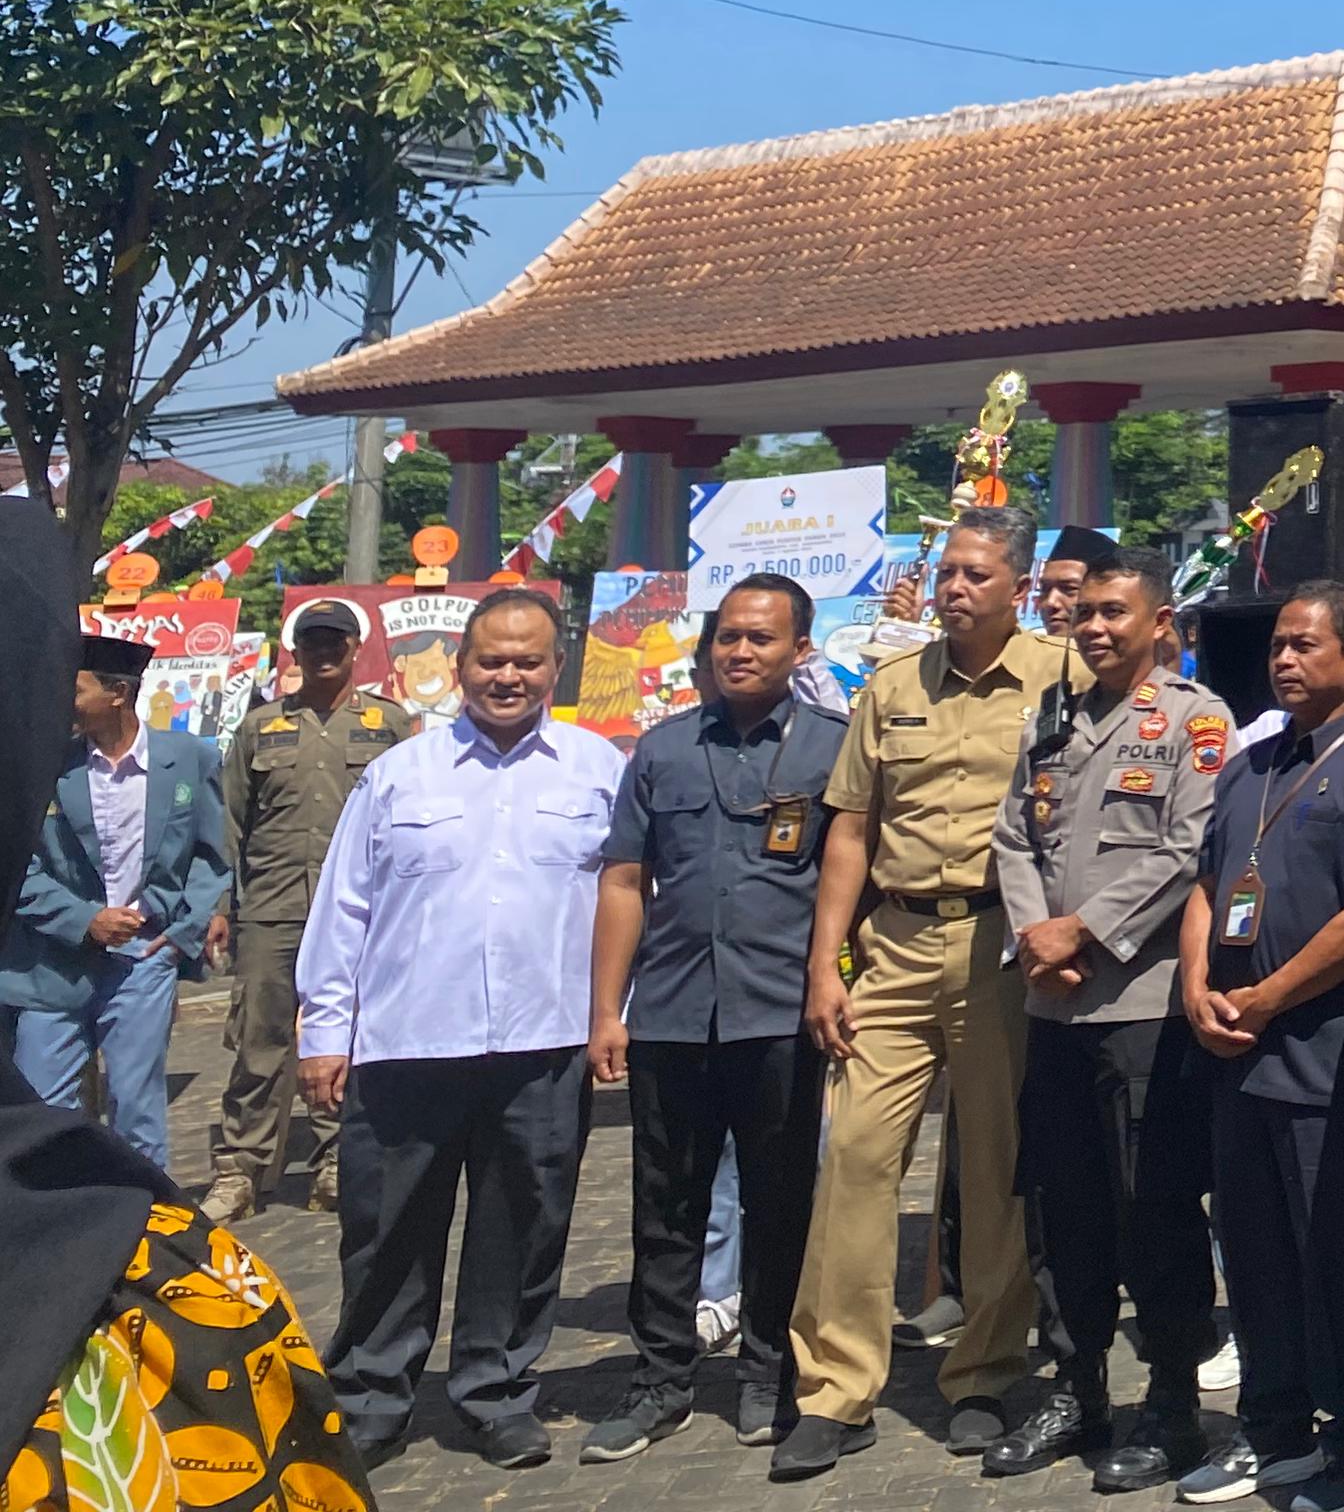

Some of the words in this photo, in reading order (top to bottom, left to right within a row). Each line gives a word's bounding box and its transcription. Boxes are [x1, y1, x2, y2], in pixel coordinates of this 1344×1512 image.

[423, 539, 449, 555] 23
[119, 567, 146, 582] 22
[401, 598, 478, 614] GOLPU
[388, 619, 403, 632] IS
[406, 614, 437, 628] NOT
[1117, 745, 1173, 761] POLRI
